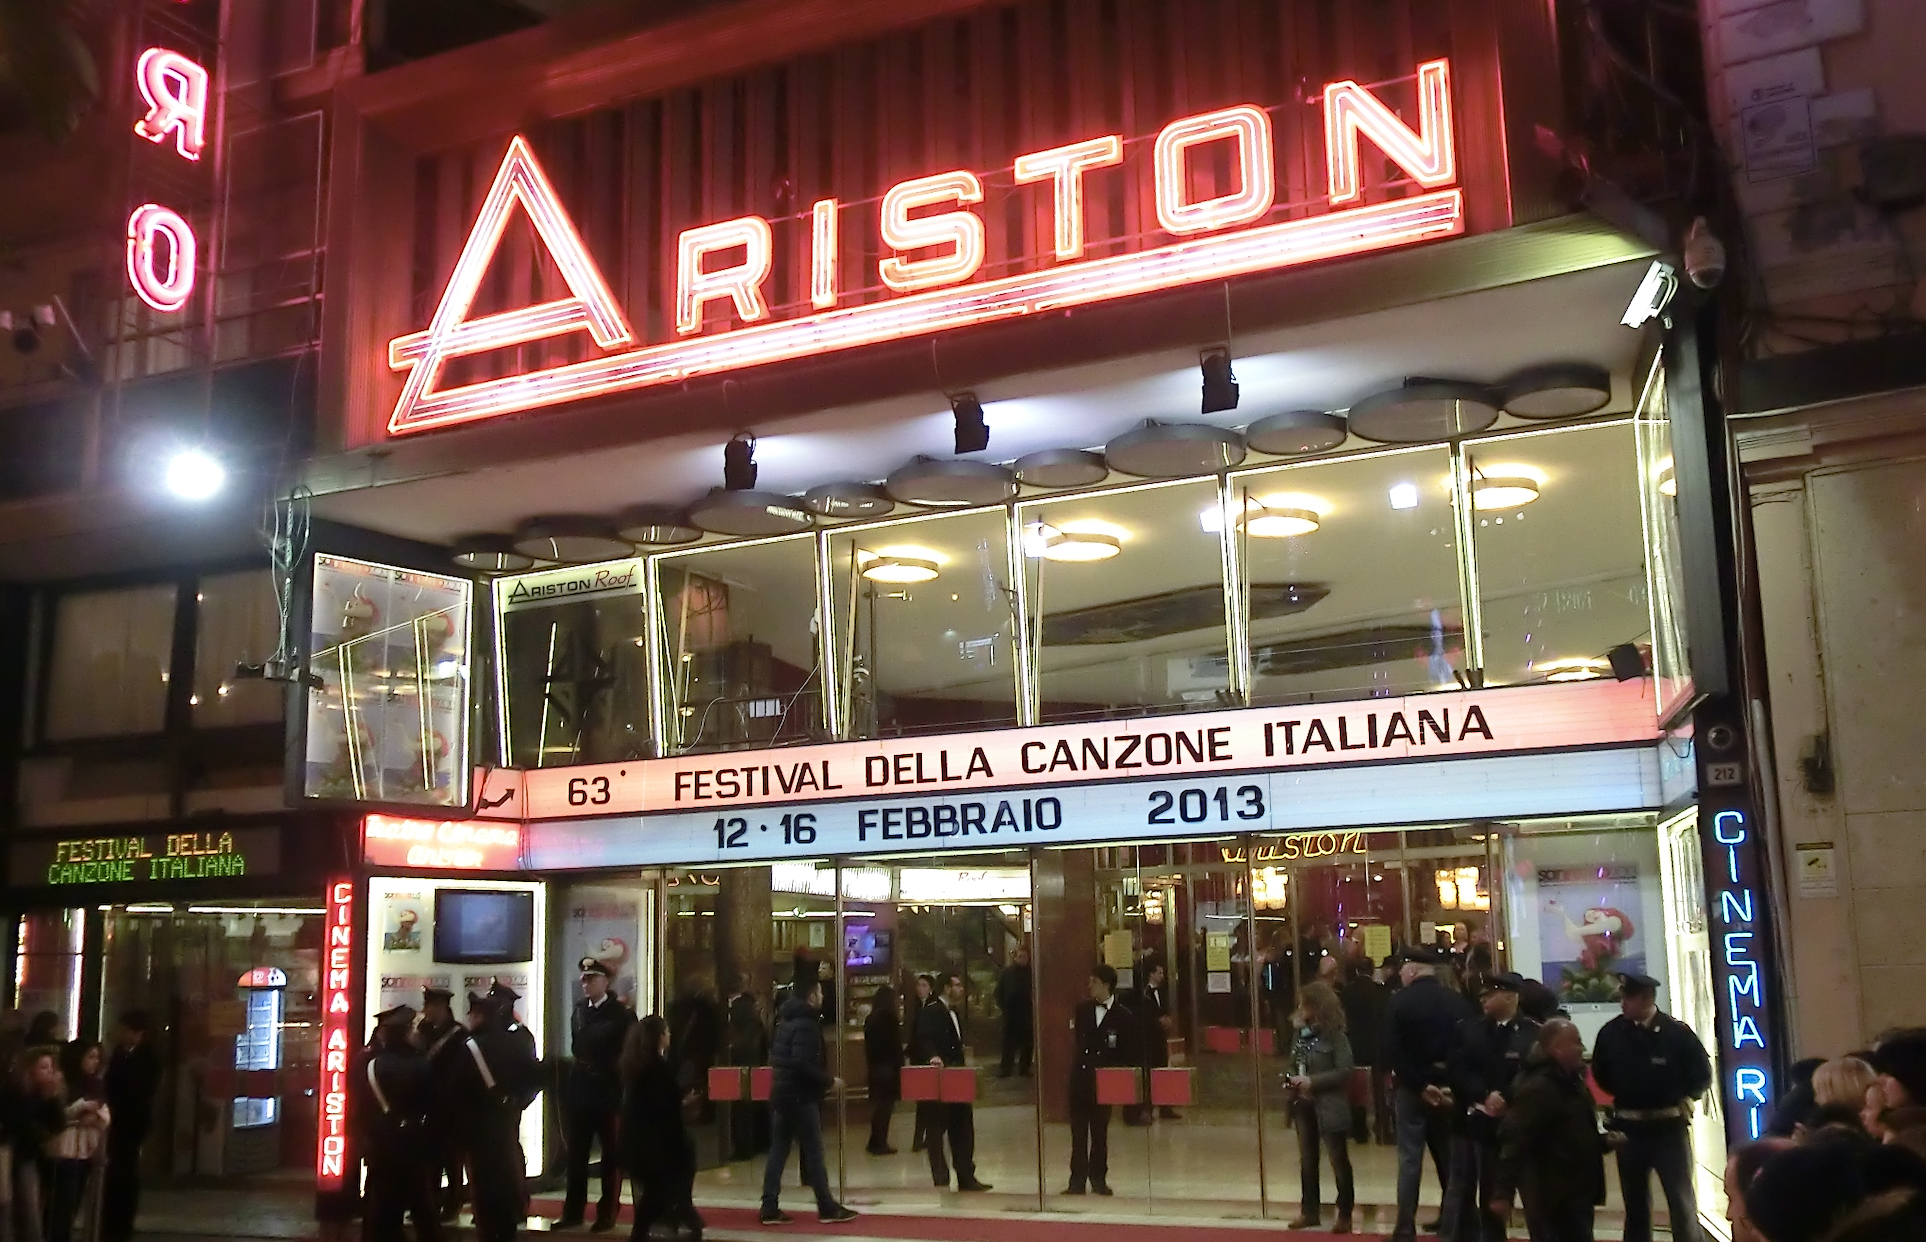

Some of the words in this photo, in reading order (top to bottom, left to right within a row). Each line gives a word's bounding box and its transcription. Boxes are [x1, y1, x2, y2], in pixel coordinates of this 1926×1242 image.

[387, 56, 1465, 434] ARISTON
[508, 579, 591, 605] ARISTON
[595, 564, 637, 590] Roof
[674, 760, 843, 802] FESTIVAL
[865, 747, 994, 788] DELLA
[1021, 727, 1233, 775] CANZONE
[1264, 705, 1494, 757] ITALIANA
[1714, 768, 1735, 780] 212
[56, 837, 153, 862] FESTIVAL
[166, 831, 233, 857] DELLA
[858, 796, 1062, 842] FEBBRAIO
[1148, 785, 1265, 825] 2013
[49, 860, 135, 885] CANZONE
[149, 854, 245, 880] ITALIANA
[329, 883, 352, 1013] CINEMA
[1713, 810, 1764, 1049] CINEMA
[322, 1028, 346, 1177] ARISTON
